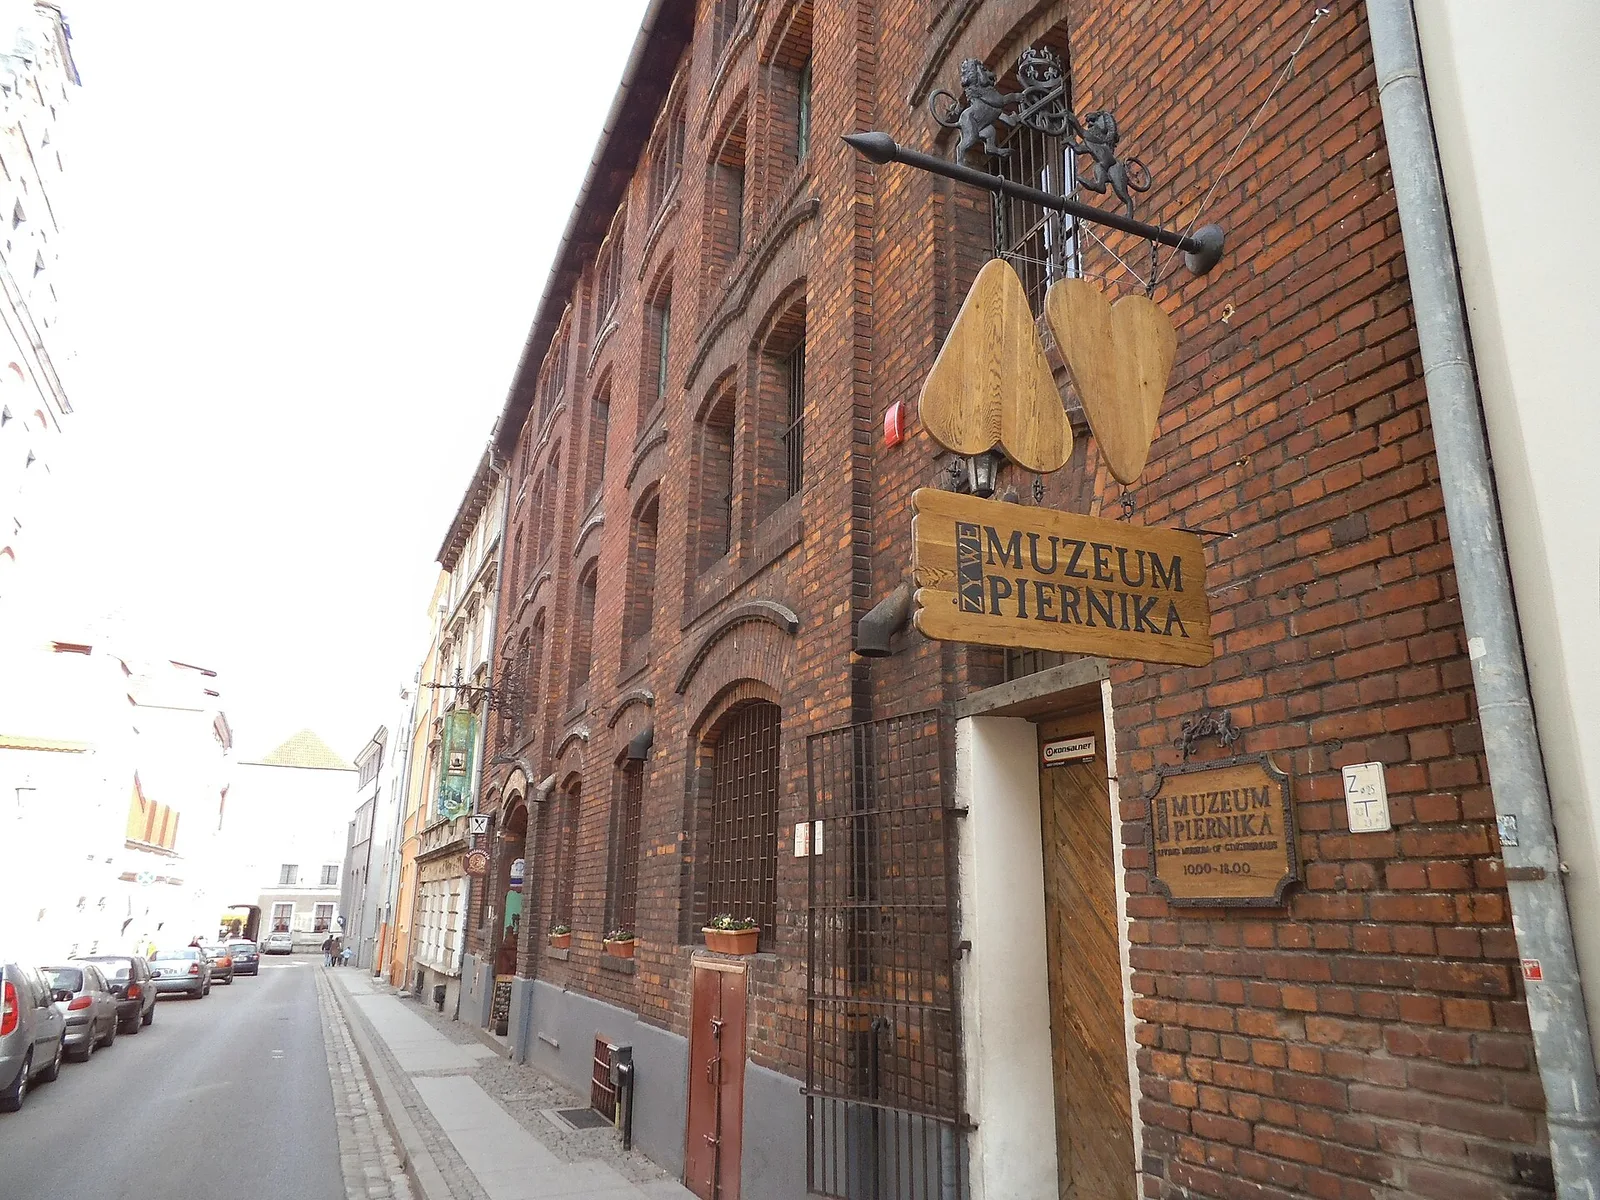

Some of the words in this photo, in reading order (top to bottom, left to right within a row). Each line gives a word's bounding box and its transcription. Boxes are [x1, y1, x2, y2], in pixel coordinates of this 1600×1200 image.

[983, 525, 1184, 592] MUZEUM
[987, 574, 1191, 638] PIERNIKA
[1346, 774, 1359, 793] Z
[1171, 785, 1271, 817] MUZEUM
[1174, 811, 1274, 841] PIERNIKA
